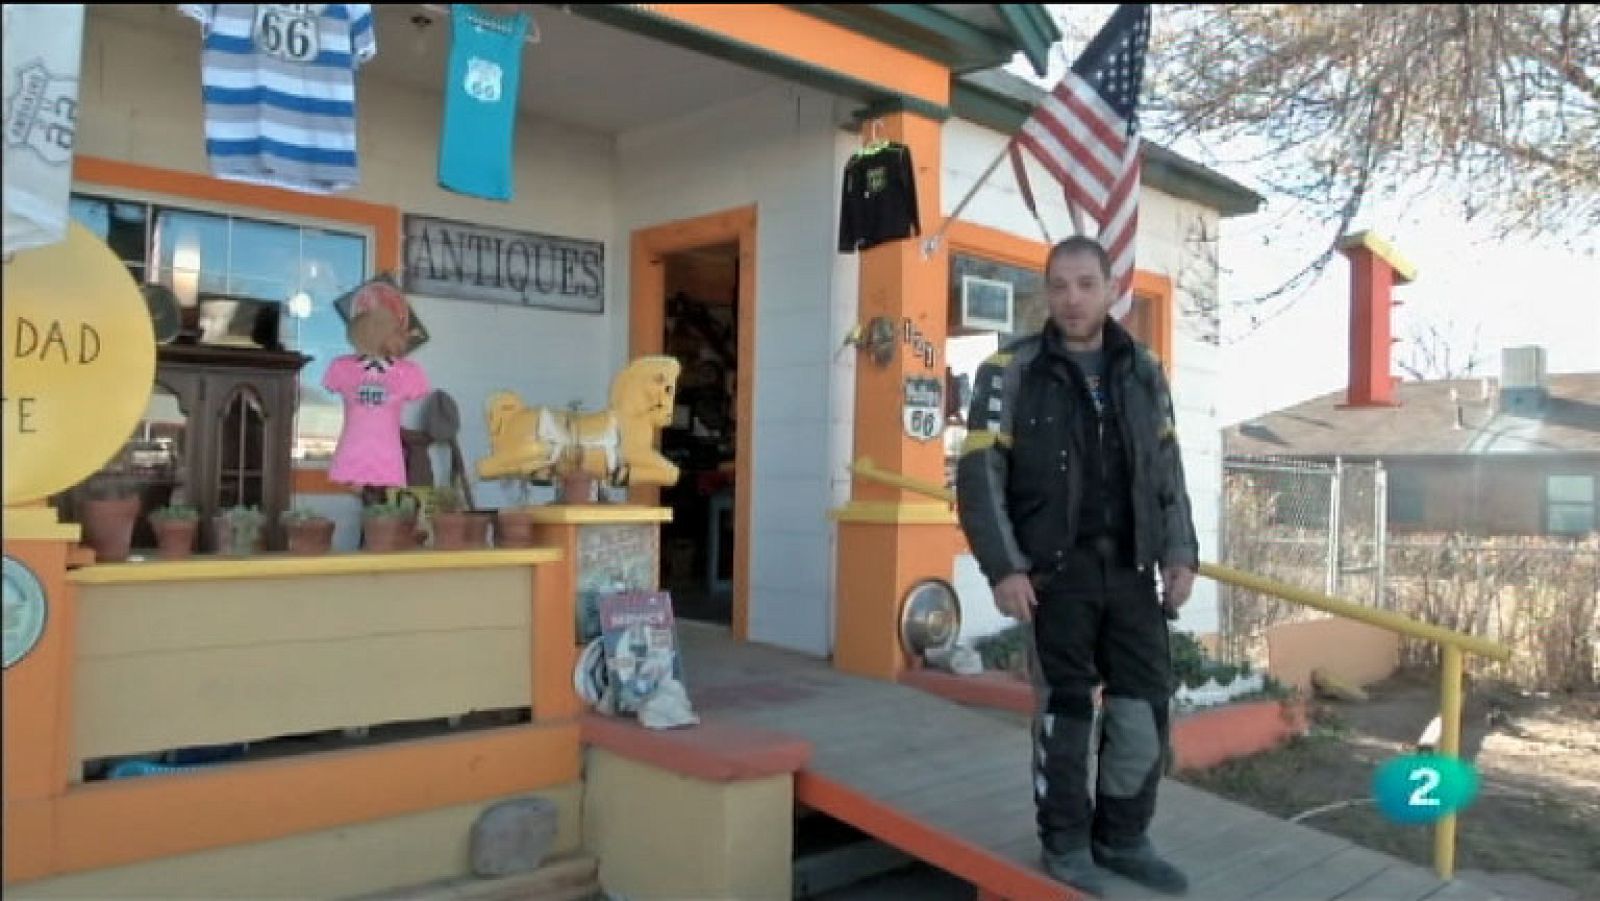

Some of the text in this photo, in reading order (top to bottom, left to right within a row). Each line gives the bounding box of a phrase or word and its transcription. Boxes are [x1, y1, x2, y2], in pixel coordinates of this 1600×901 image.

[262, 10, 310, 58] 66
[408, 224, 601, 304] ANTIQUES
[910, 409, 936, 437] 66
